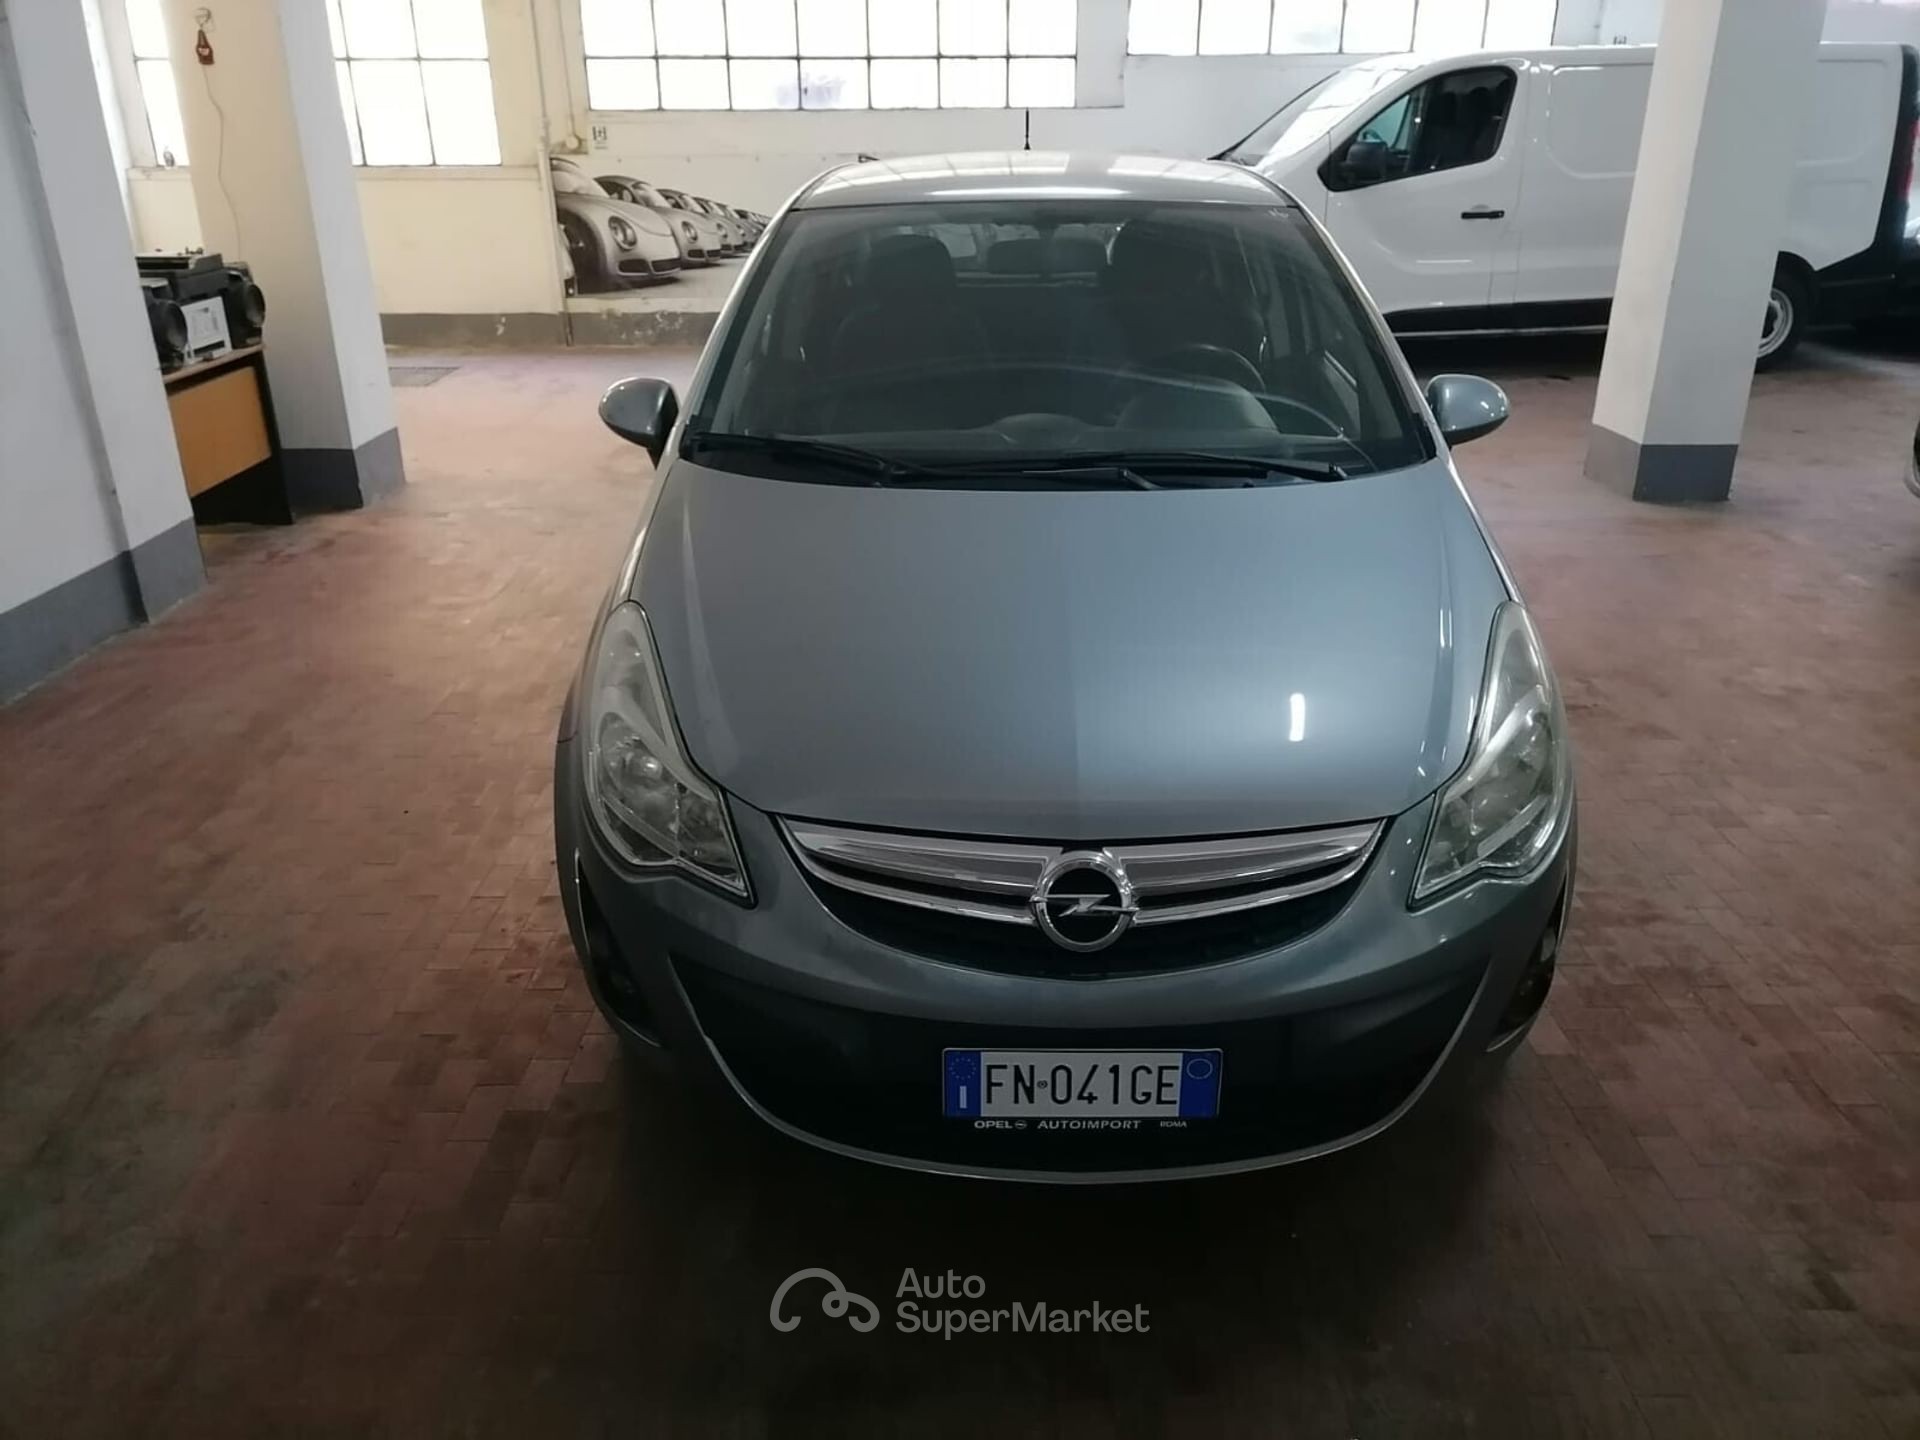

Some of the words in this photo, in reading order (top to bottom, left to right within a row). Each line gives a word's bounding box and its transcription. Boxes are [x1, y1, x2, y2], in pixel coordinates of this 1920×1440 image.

[974, 1120, 1013, 1129] OPEL
[1037, 1119, 1142, 1129] AUTOIMPORT
[1159, 1120, 1187, 1128] ROMA
